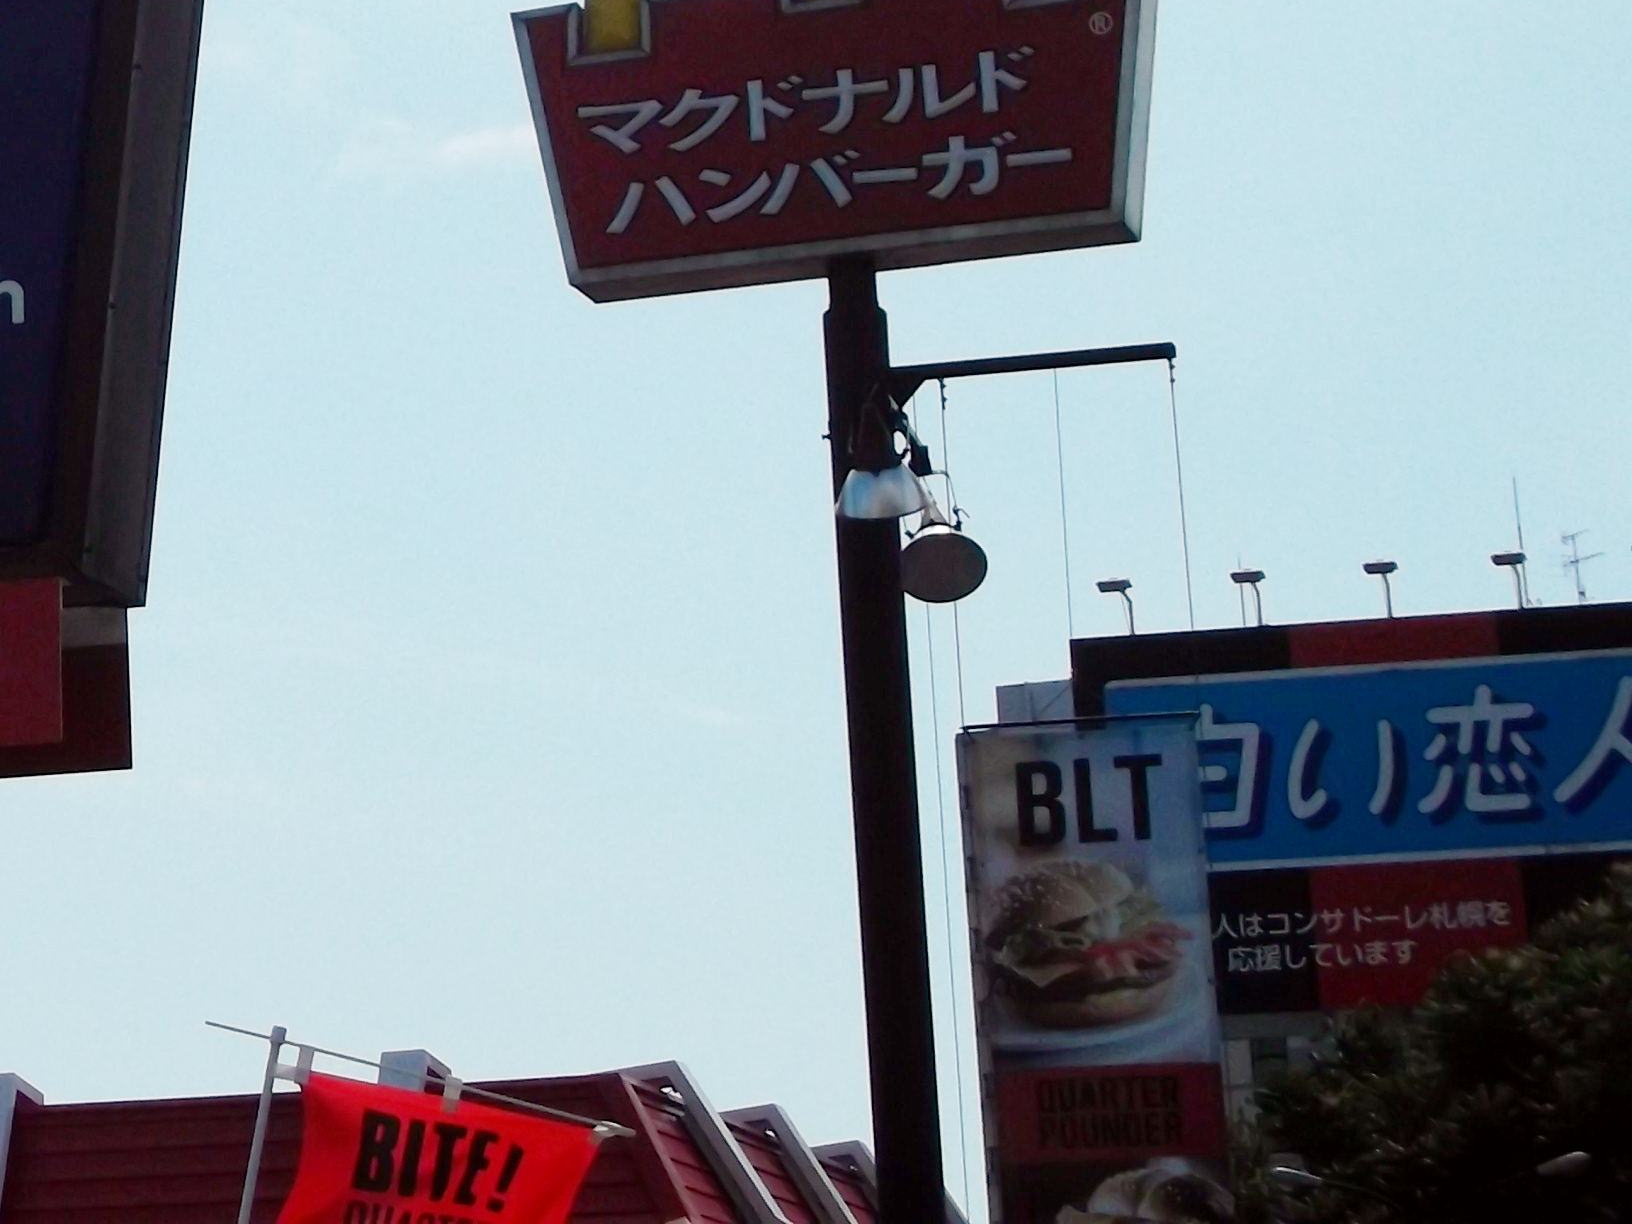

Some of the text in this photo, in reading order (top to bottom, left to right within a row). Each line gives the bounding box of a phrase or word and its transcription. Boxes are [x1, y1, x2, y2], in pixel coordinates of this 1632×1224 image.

[577, 44, 1036, 153] マクドナルド
[605, 129, 1073, 235] ハンバーガー
[1014, 753, 1163, 848] BLT
[1227, 940, 1420, 973] 応援しています
[1035, 1075, 1181, 1113] QUARTER
[1037, 1109, 1183, 1150] POUNDER
[351, 1108, 525, 1213] BITE!
